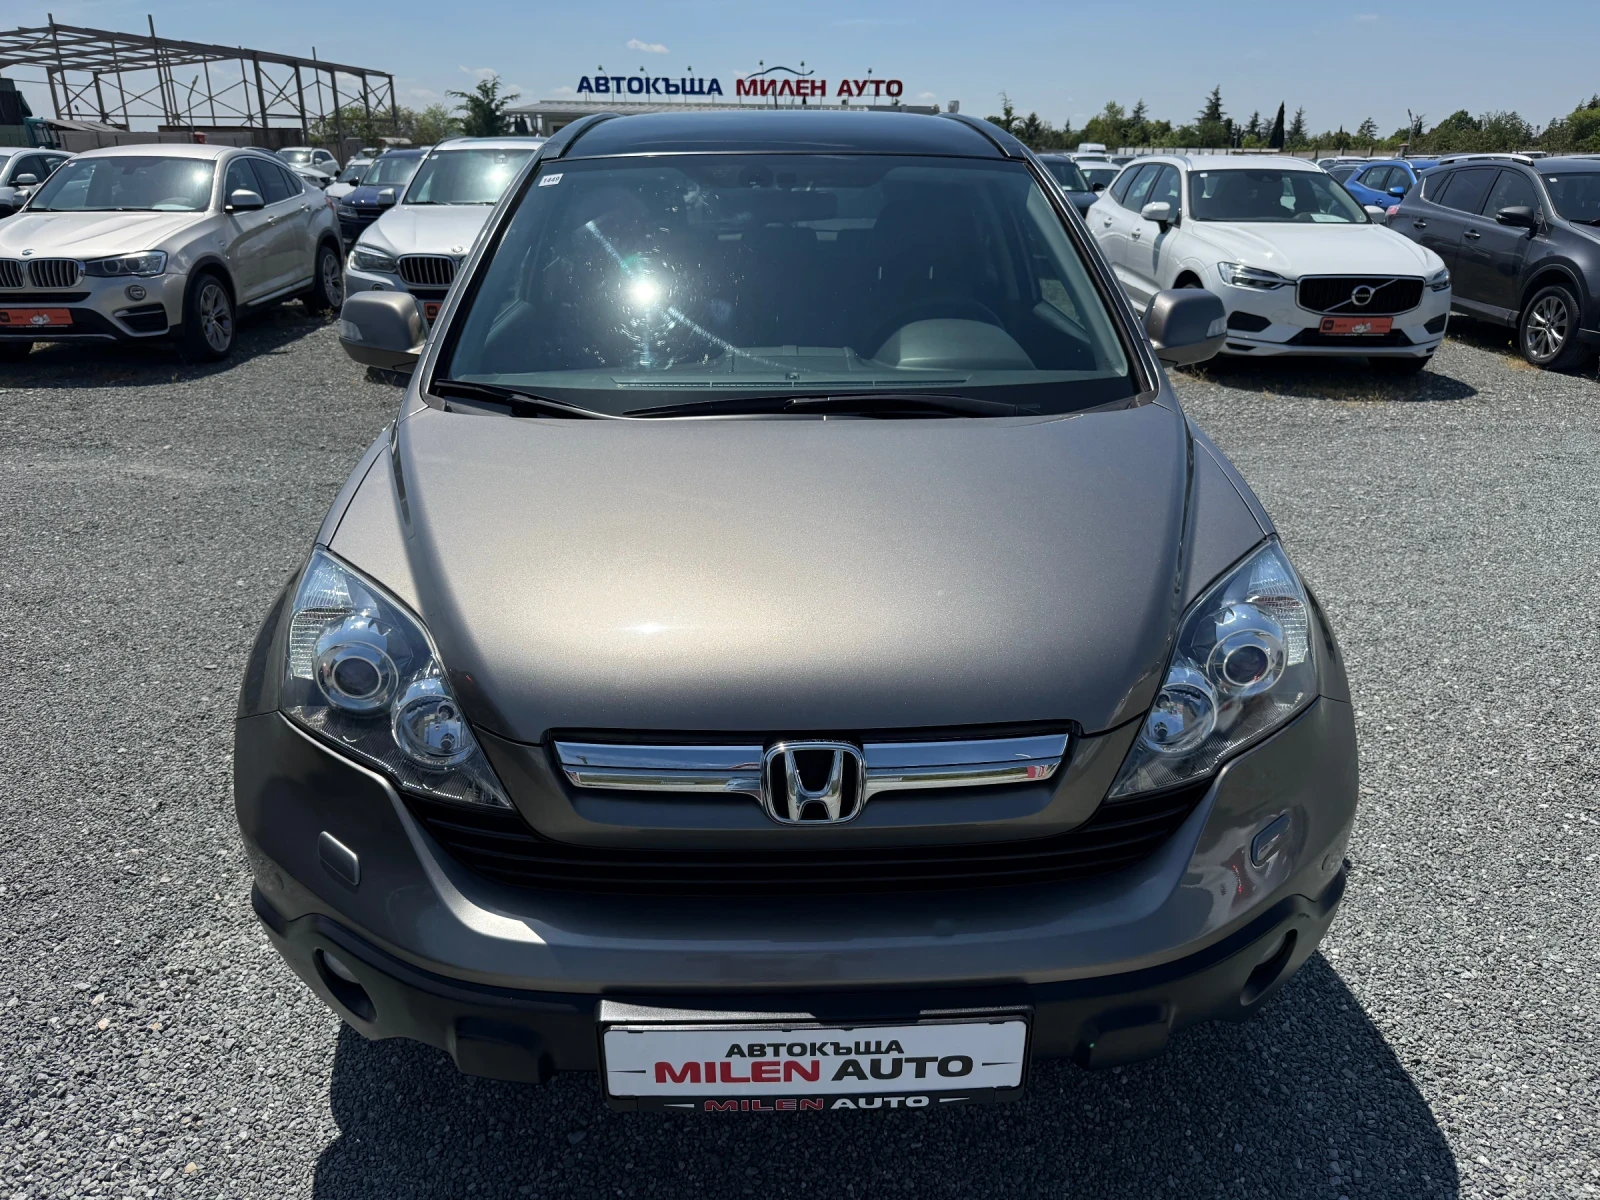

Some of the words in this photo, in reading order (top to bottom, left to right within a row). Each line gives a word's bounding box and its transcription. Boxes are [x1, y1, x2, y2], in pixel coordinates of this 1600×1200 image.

[736, 79, 826, 97] МИЛЕН
[837, 79, 903, 97] АУТО
[655, 1060, 820, 1083] MILEN
[831, 1055, 973, 1081] AUTO
[704, 1098, 824, 1111] MILEN
[830, 1096, 930, 1109] AUTO
